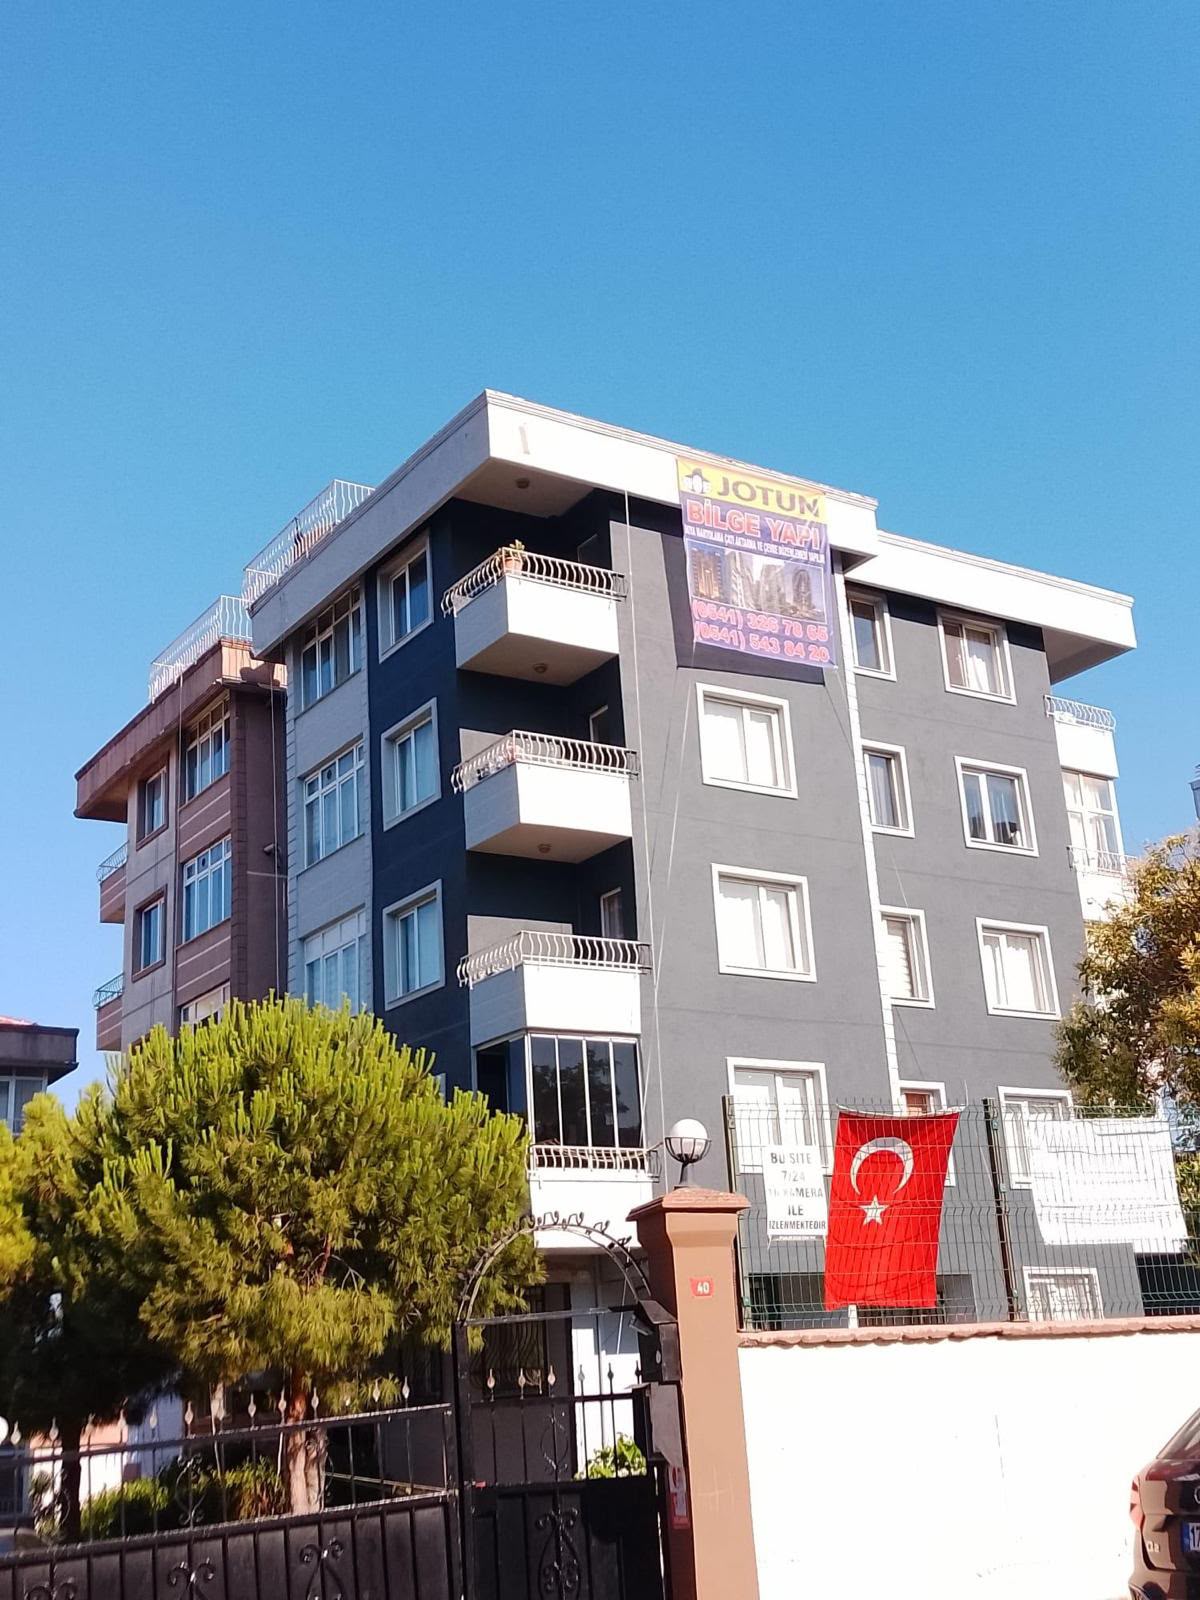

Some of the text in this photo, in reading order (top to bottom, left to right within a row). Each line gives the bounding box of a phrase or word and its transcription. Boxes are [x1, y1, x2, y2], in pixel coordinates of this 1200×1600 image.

[687, 499, 820, 550] BİLGE YAPI
[694, 621, 746, 650] (0541)
[749, 633, 780, 654] 543
[808, 645, 830, 663] 20
[770, 1152, 785, 1164] BU
[697, 1281, 710, 1295] 40
